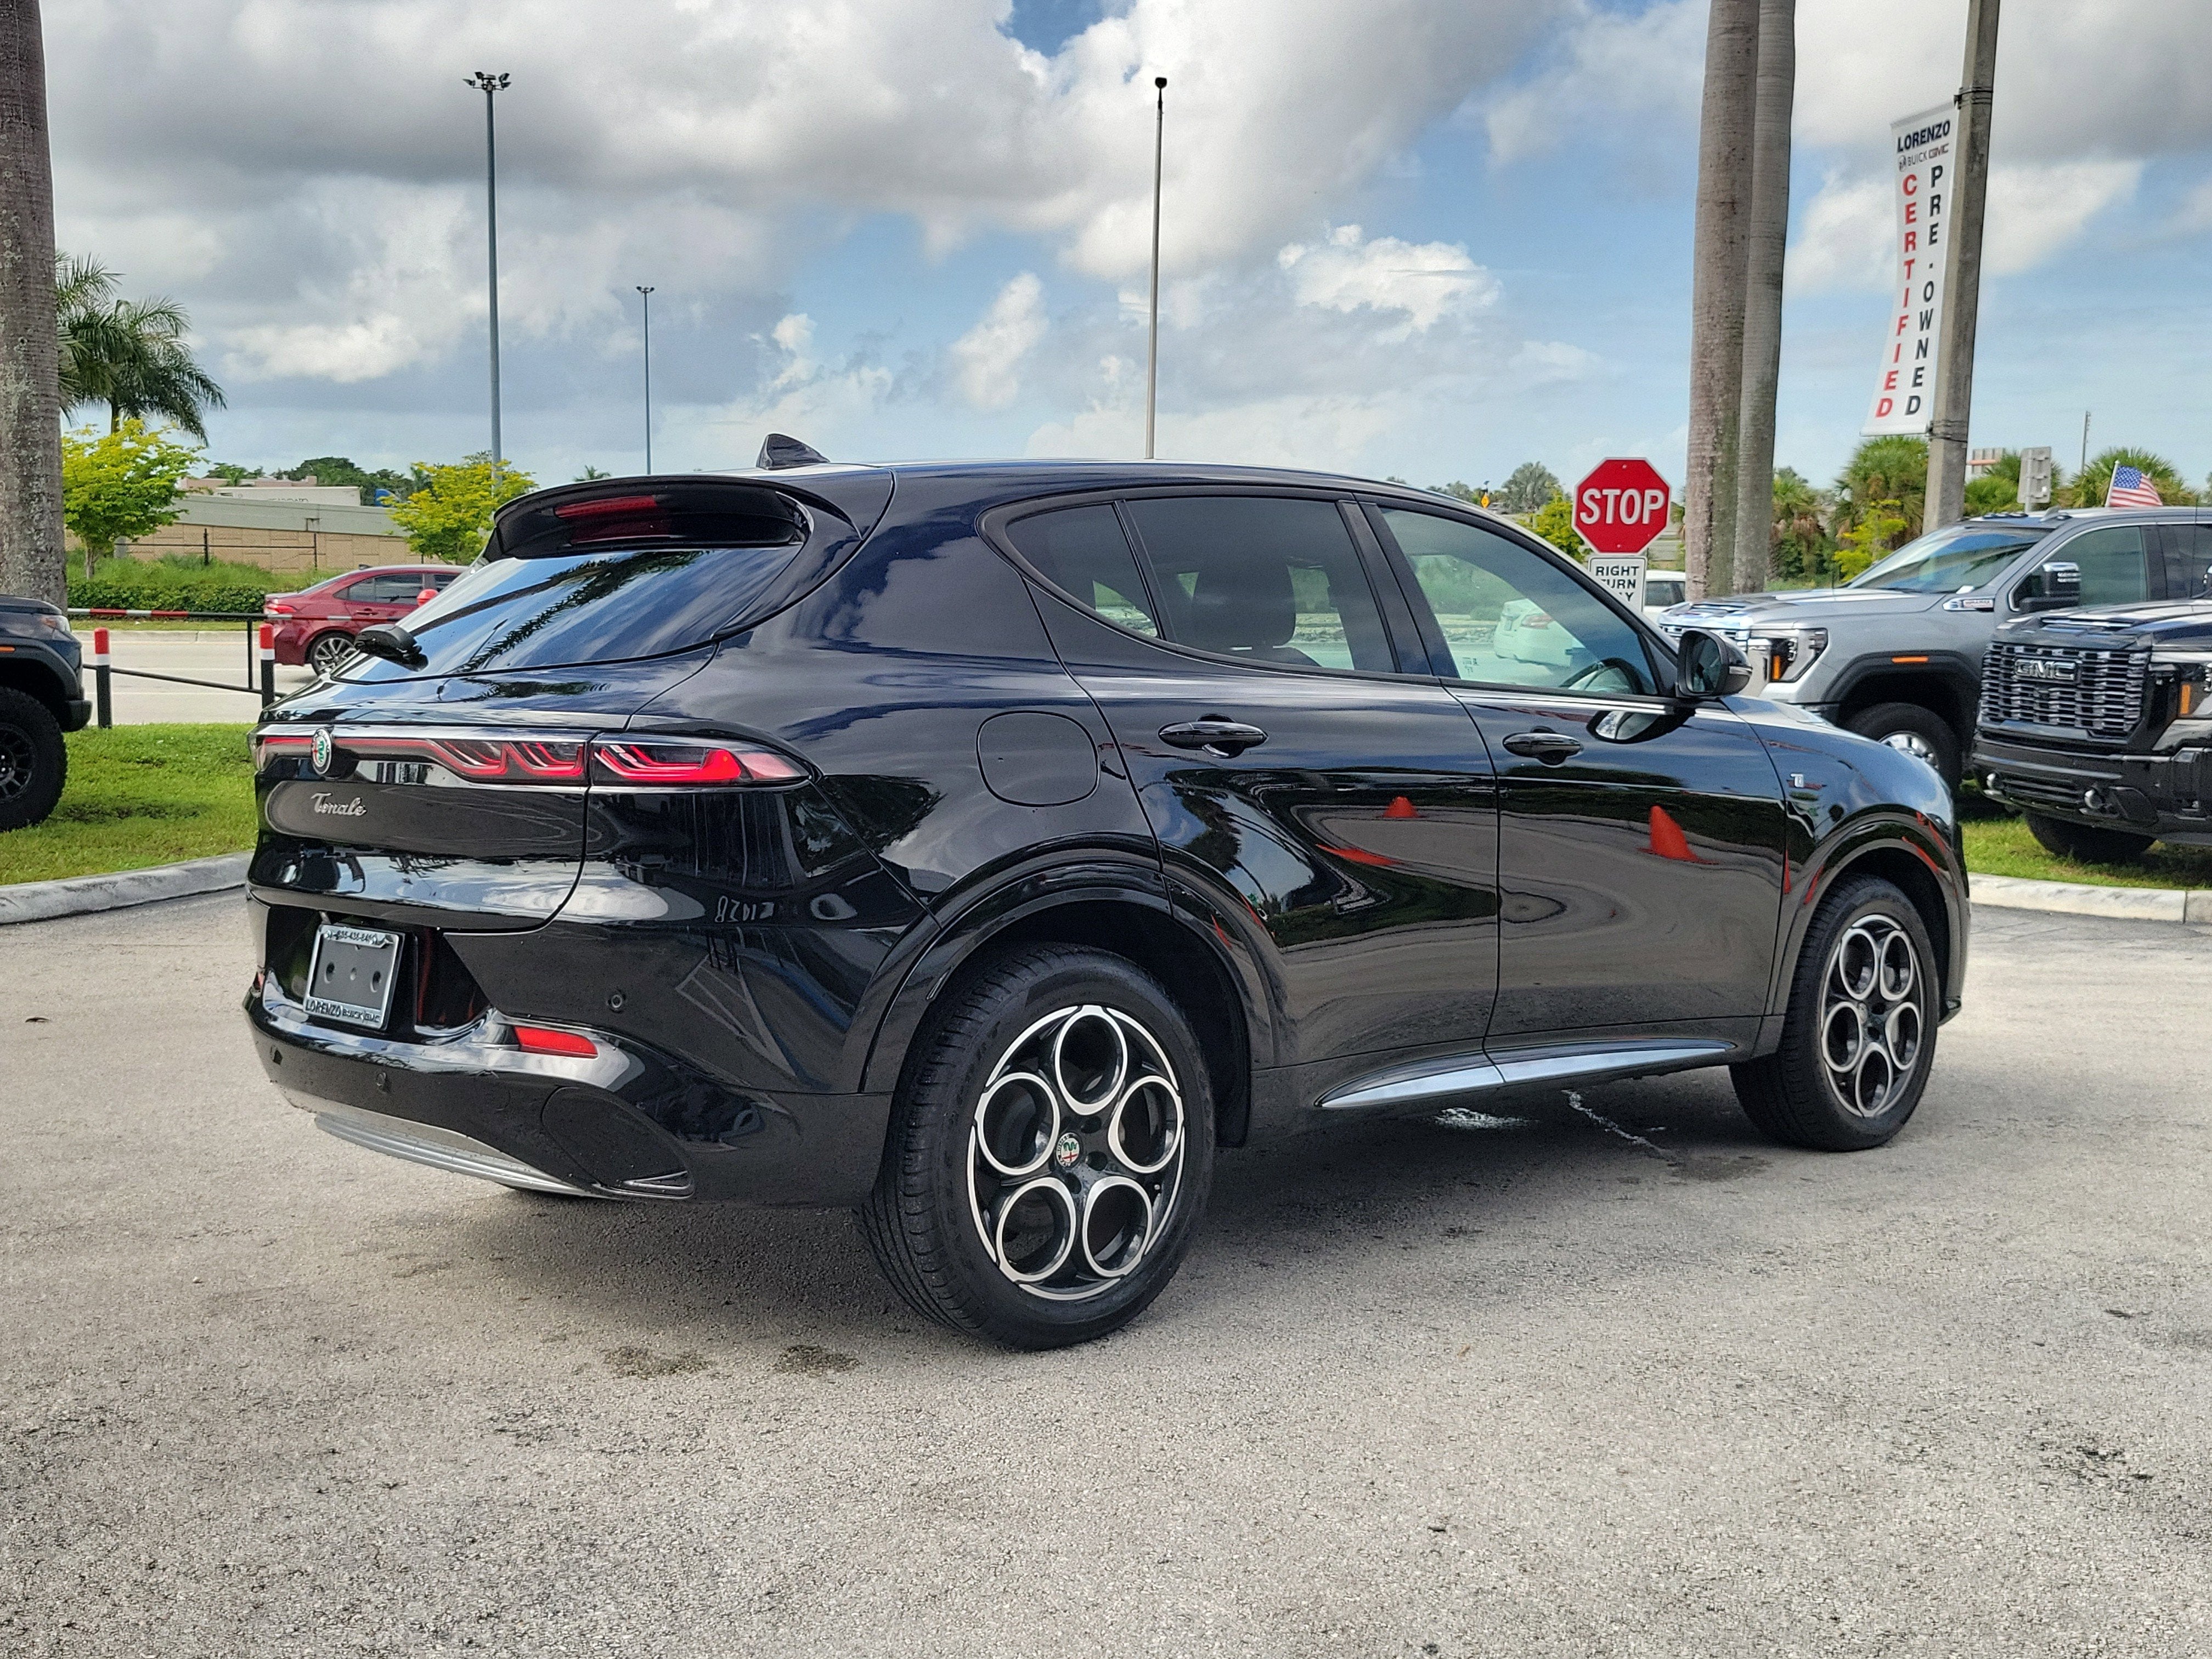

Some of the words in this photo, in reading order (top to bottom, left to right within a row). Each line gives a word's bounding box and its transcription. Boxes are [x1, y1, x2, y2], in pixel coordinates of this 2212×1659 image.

[1897, 119, 1950, 153] LORENZO
[1908, 150, 1927, 166] BUICK
[1928, 143, 1949, 159] GMC
[1875, 173, 1918, 418] CERTIFIED
[1579, 488, 1665, 525] STOP
[1595, 566, 1639, 576] RIGHT
[1600, 579, 1637, 589] URN
[2015, 659, 2076, 681] GMC
[311, 792, 367, 816] Tonale
[305, 999, 341, 1018] LORENZO
